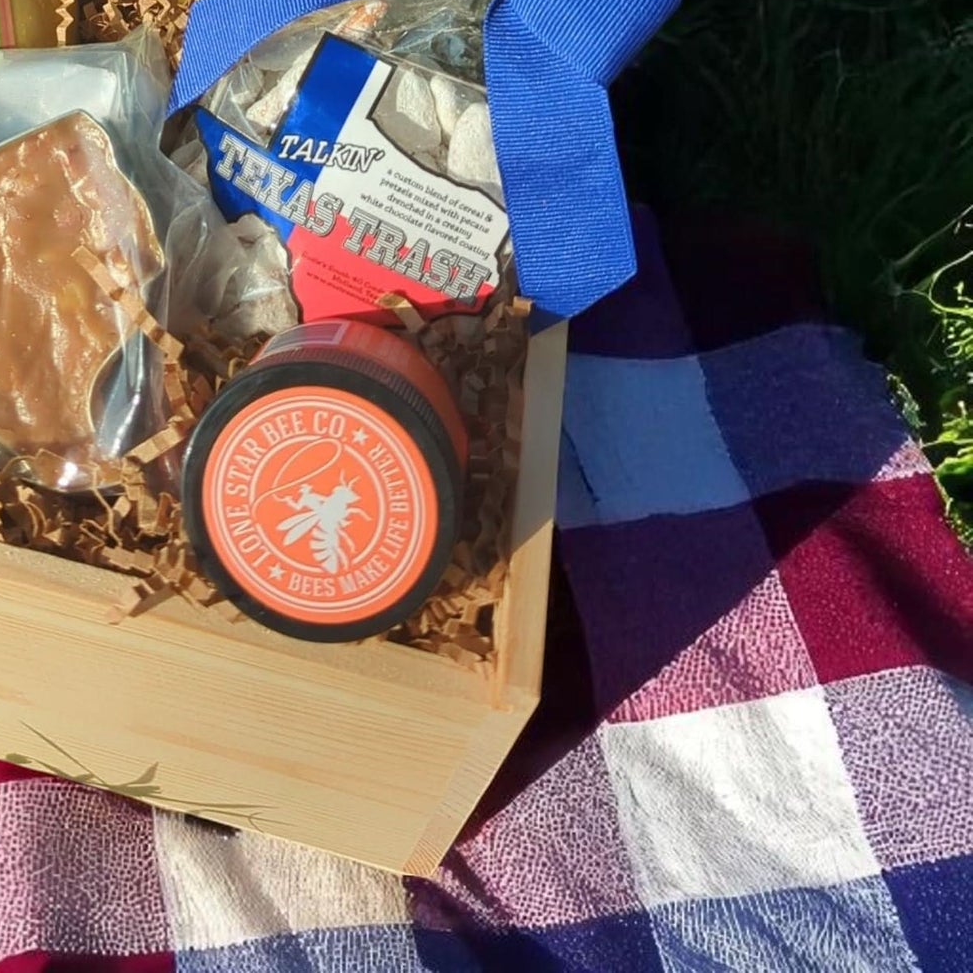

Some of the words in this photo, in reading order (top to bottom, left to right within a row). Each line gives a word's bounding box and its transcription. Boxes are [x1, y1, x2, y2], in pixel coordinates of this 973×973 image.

[215, 131, 344, 238] TEXAS
[341, 206, 493, 306] TRASH
[379, 178, 414, 199] pretzels
[413, 194, 440, 212] mixed
[440, 205, 460, 221] with
[460, 215, 490, 234] pecans
[386, 194, 425, 217] drenched
[425, 210, 435, 221] in
[435, 216, 442, 224] a
[442, 220, 473, 240] creamy
[393, 171, 424, 191] custom
[425, 182, 449, 203] blend
[448, 196, 460, 207] of
[458, 202, 485, 220] cereal
[484, 213, 494, 223] &
[360, 193, 384, 209] white
[384, 204, 424, 228] chocolate
[424, 221, 457, 245] flavored
[458, 239, 491, 260] coating
[259, 410, 308, 445] BEE
[226, 437, 267, 497] STAR
[367, 443, 411, 512] BETTER
[226, 505, 272, 568] LONE
[388, 517, 410, 559] LIFE
[288, 570, 336, 597] BEES
[339, 555, 391, 594] MAKE
